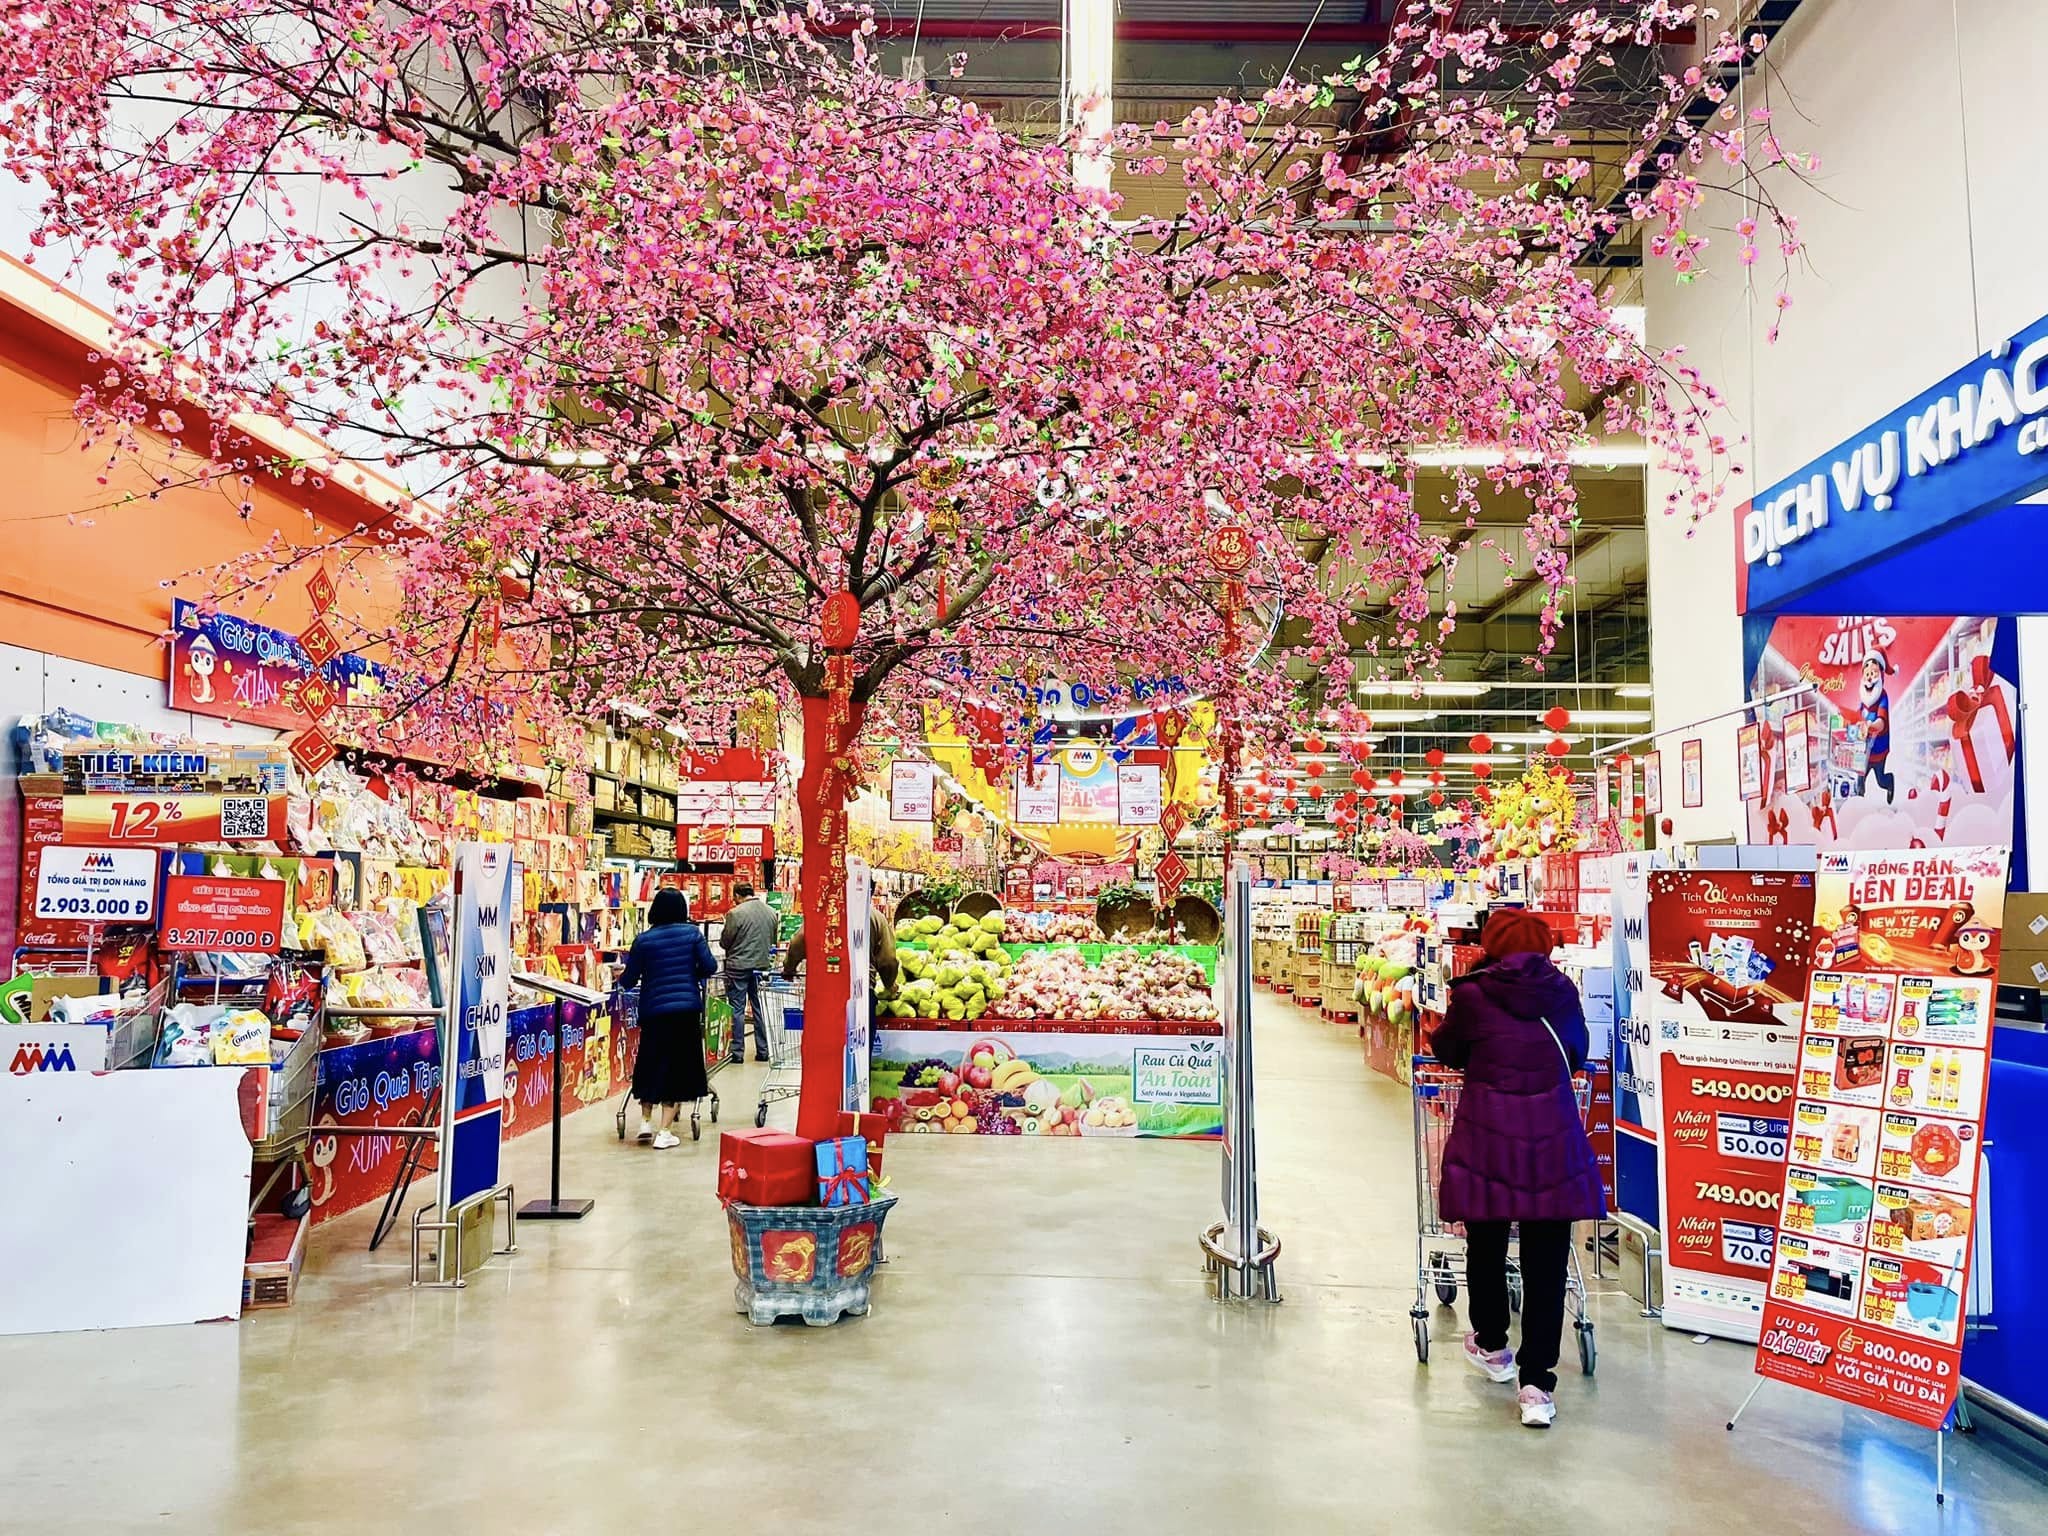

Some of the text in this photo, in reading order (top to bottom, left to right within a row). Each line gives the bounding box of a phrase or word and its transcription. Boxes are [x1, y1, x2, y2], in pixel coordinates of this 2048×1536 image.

[1743, 474, 1829, 567] DỊCH
[1832, 431, 1902, 512] VỤ
[1818, 616, 1898, 666] SALES
[79, 748, 207, 777] TIẾT KIỆM
[904, 803, 917, 812] 59
[1030, 805, 1042, 815] 75
[109, 801, 182, 839] 12%
[47, 873, 147, 888] TỔNG GIÁ TRỊ ĐƠN HÀNG
[1850, 875, 1974, 905] LÊN DEAL
[40, 897, 149, 916] 2.903.000 Đ
[1681, 892, 1702, 902] Tích
[1730, 893, 1745, 902] An
[1746, 893, 1778, 906] Khang
[477, 905, 499, 929] MM
[1688, 906, 1707, 914] Xuân
[1624, 918, 1642, 940] MM
[1869, 915, 1941, 931] NEW YEAR
[168, 927, 275, 947] 3.217.000 Đ
[1885, 928, 1916, 938] 2025
[475, 954, 496, 979] XIN
[1624, 972, 1643, 993] XIN
[465, 1001, 501, 1031] CHÀO
[1813, 1019, 1827, 1029] 99
[1618, 1015, 1650, 1046] CHÀO
[1683, 1026, 1688, 1036] 1
[1722, 1029, 1731, 1040] 2
[516, 1033, 537, 1062] Giỏ
[1142, 1053, 1212, 1070] Rau Củ Quả
[1709, 1056, 1728, 1065] hàng
[1141, 1070, 1211, 1088] An Toàn
[335, 1069, 409, 1116] Giỏ Quà
[1805, 1085, 1818, 1096] 65
[1673, 1110, 1711, 1127] Nhận
[1674, 1128, 1708, 1142] ngay
[1724, 1136, 1784, 1157] 50.00
[1797, 1149, 1809, 1160] 79
[1881, 1164, 1898, 1177] 129
[1677, 1216, 1716, 1234] Nhận
[1783, 1216, 1802, 1229] 299
[1677, 1234, 1714, 1248] ngay
[1872, 1235, 1890, 1248] 149
[1775, 1284, 1794, 1298] 999
[1864, 1307, 1882, 1321] 199
[1776, 1316, 1819, 1337] ƯU ĐÃI
[1763, 1331, 1795, 1353] ĐẶC
[1793, 1340, 1831, 1364] BIỆT
[1863, 1341, 1932, 1372] 800.000
[1936, 1360, 1950, 1376] Đ
[1835, 1361, 1860, 1380] VỚI
[1863, 1370, 1889, 1389] GIÁ
[1893, 1379, 1915, 1396] ƯU
[1918, 1386, 1946, 1405] ĐÃI
